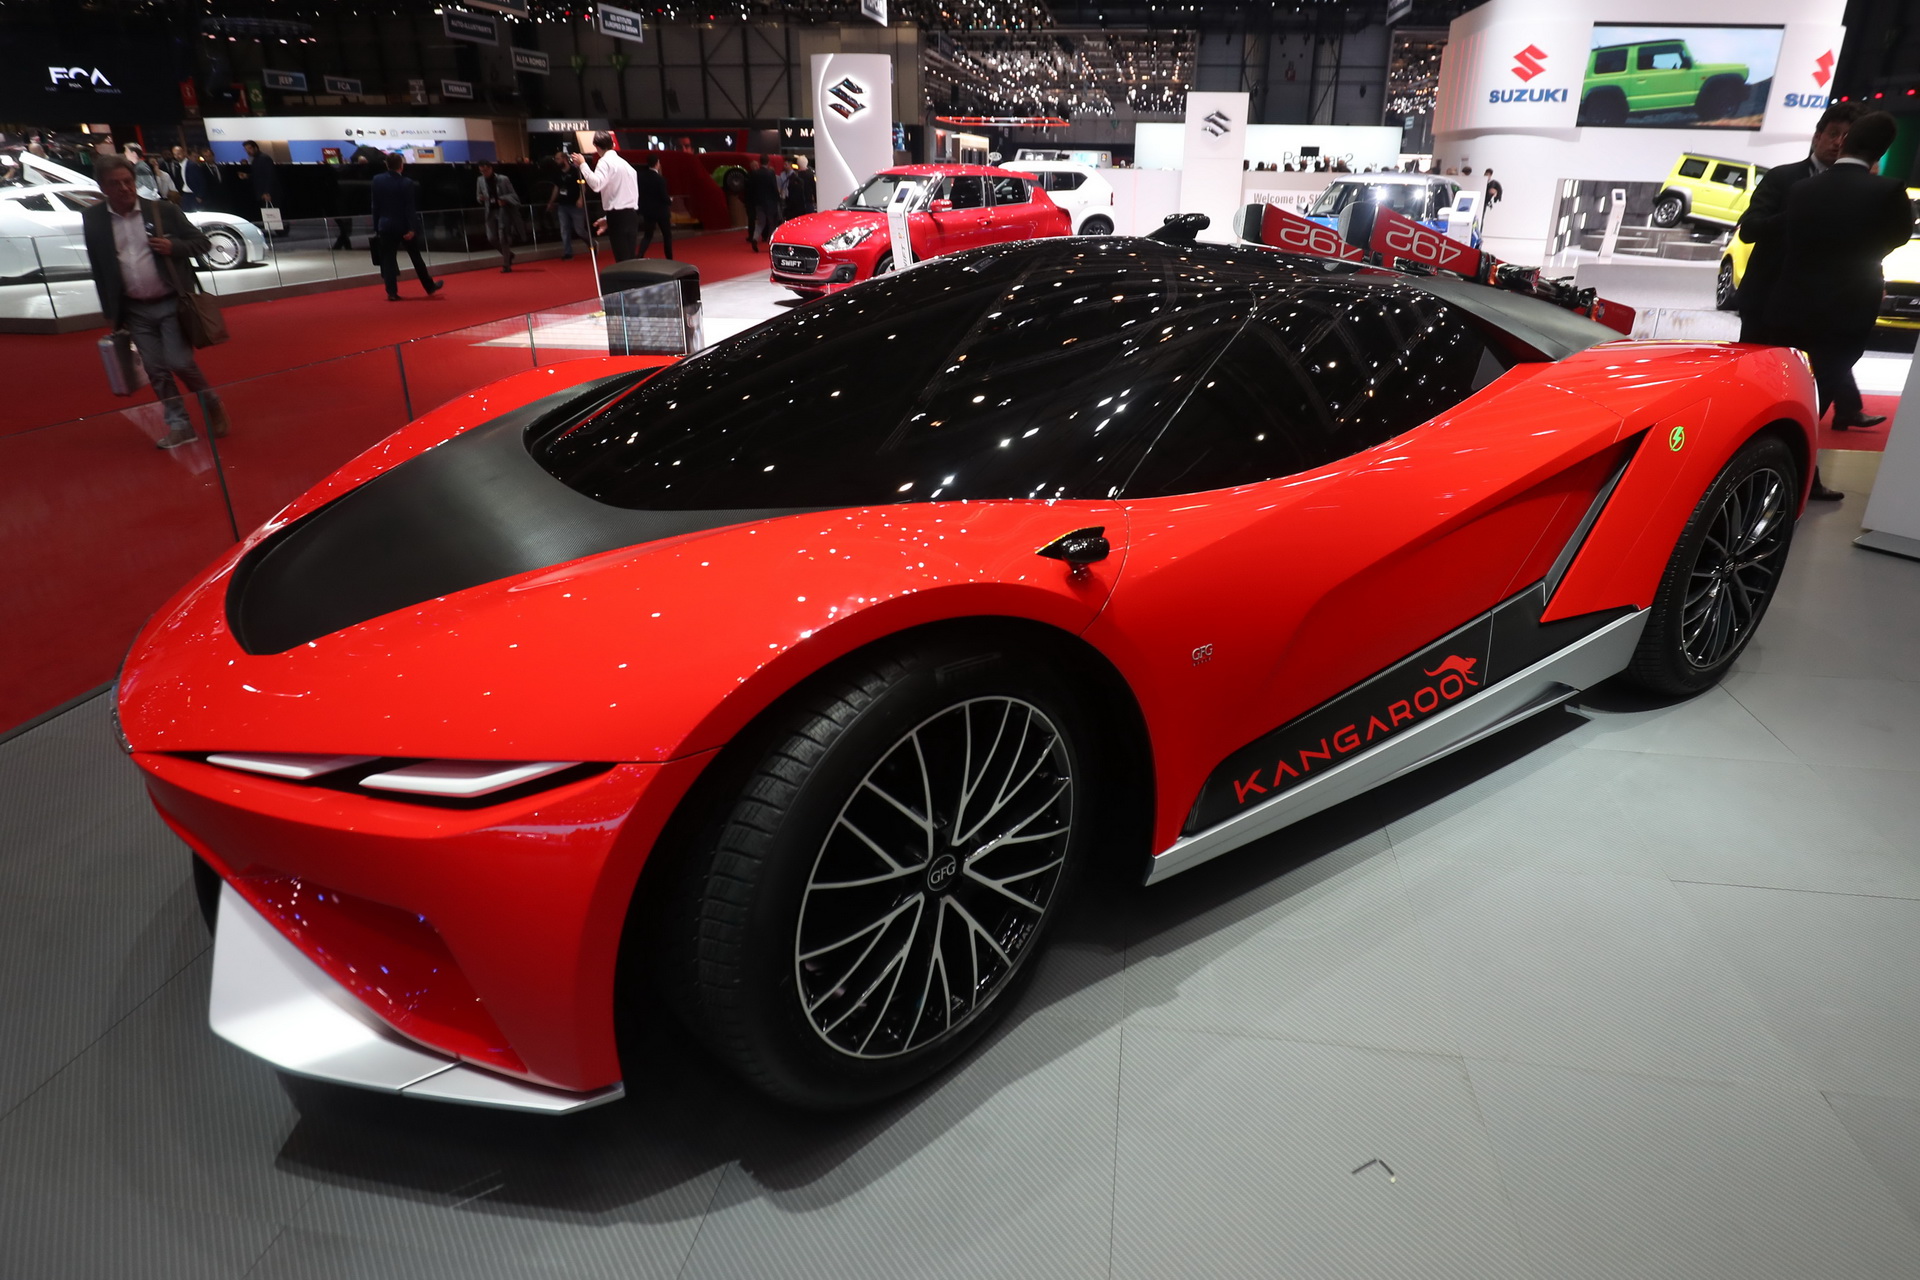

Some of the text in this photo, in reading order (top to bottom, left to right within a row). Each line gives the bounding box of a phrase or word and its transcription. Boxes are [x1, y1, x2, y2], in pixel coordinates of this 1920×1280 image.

[1489, 88, 1569, 104] SUZUKI
[1253, 192, 1294, 205] Welcome
[1297, 194, 1306, 205] to
[1386, 219, 1462, 265] 492
[780, 259, 802, 268] SWIFT
[1192, 643, 1213, 661] GFG
[1234, 674, 1465, 805] KANGAROO
[930, 861, 956, 884] GFG
